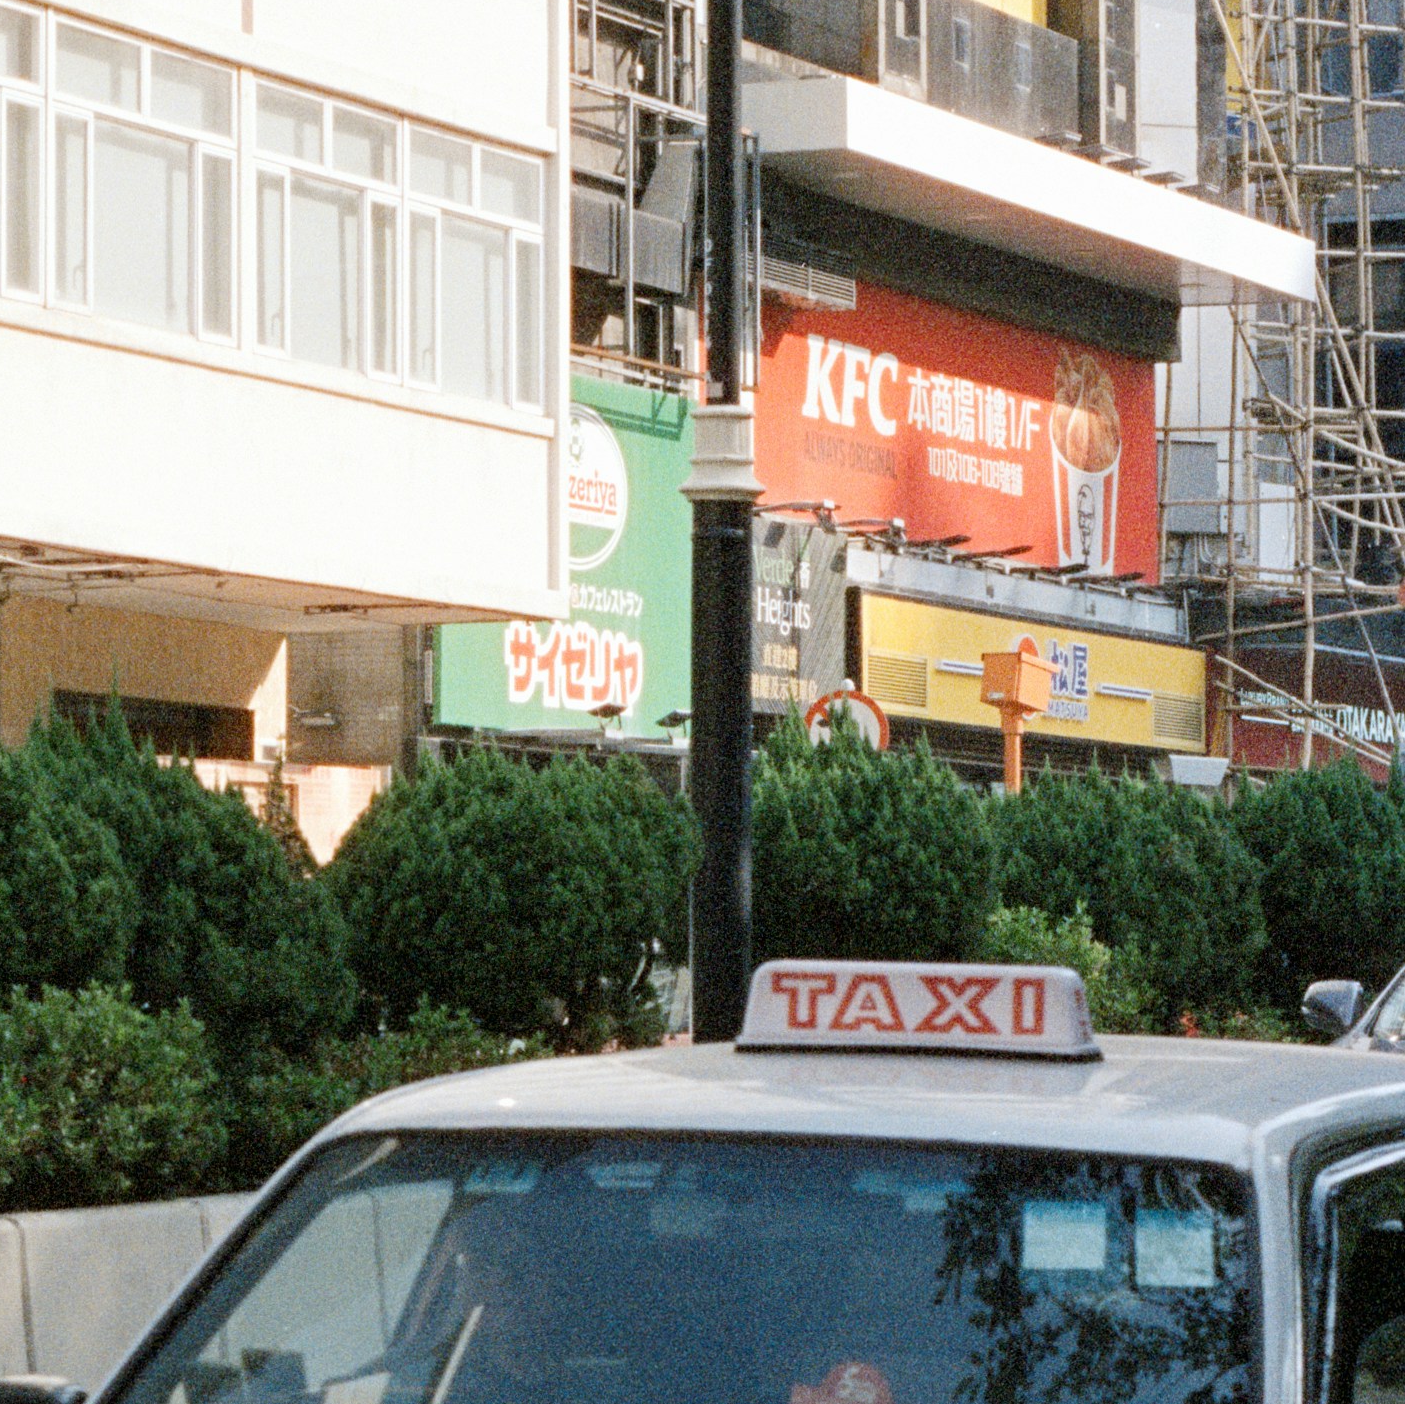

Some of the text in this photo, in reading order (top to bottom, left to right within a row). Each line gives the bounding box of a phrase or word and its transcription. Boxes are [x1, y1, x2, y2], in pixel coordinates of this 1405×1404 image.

[802, 334, 898, 436] KFC
[753, 548, 795, 585] Verde
[757, 586, 811, 635] Heights
[508, 624, 640, 710] サイゼリヤ
[1051, 640, 1088, 696] 松屋
[772, 971, 1046, 1036] TAXI
